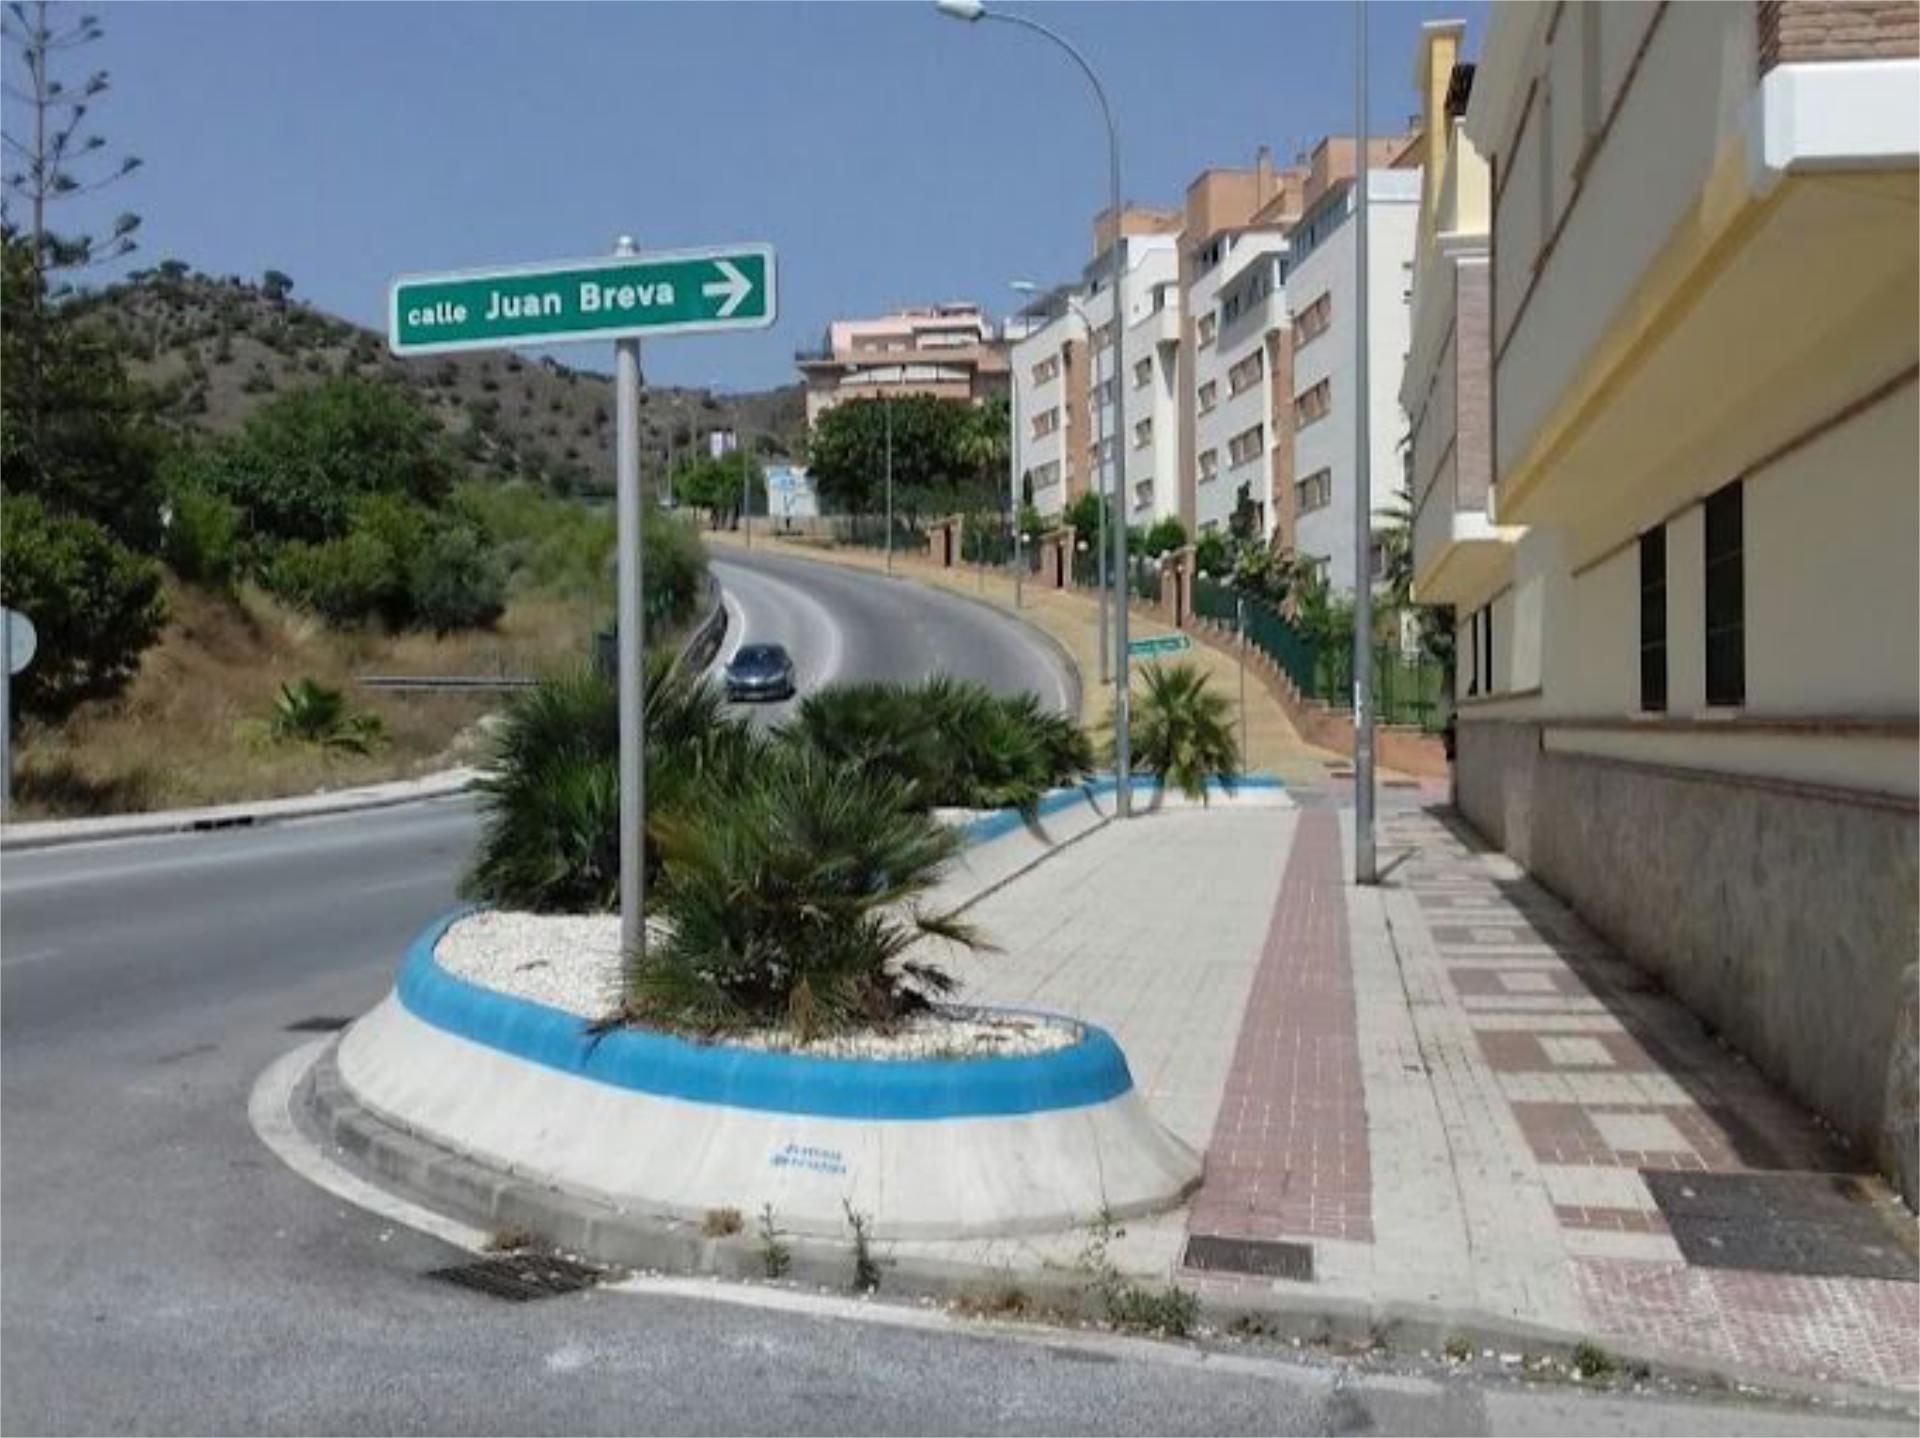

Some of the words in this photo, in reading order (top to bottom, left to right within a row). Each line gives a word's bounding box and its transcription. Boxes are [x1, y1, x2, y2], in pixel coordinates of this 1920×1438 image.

[408, 301, 467, 326] calle
[485, 291, 562, 320] Juan
[579, 281, 675, 311] Breva
